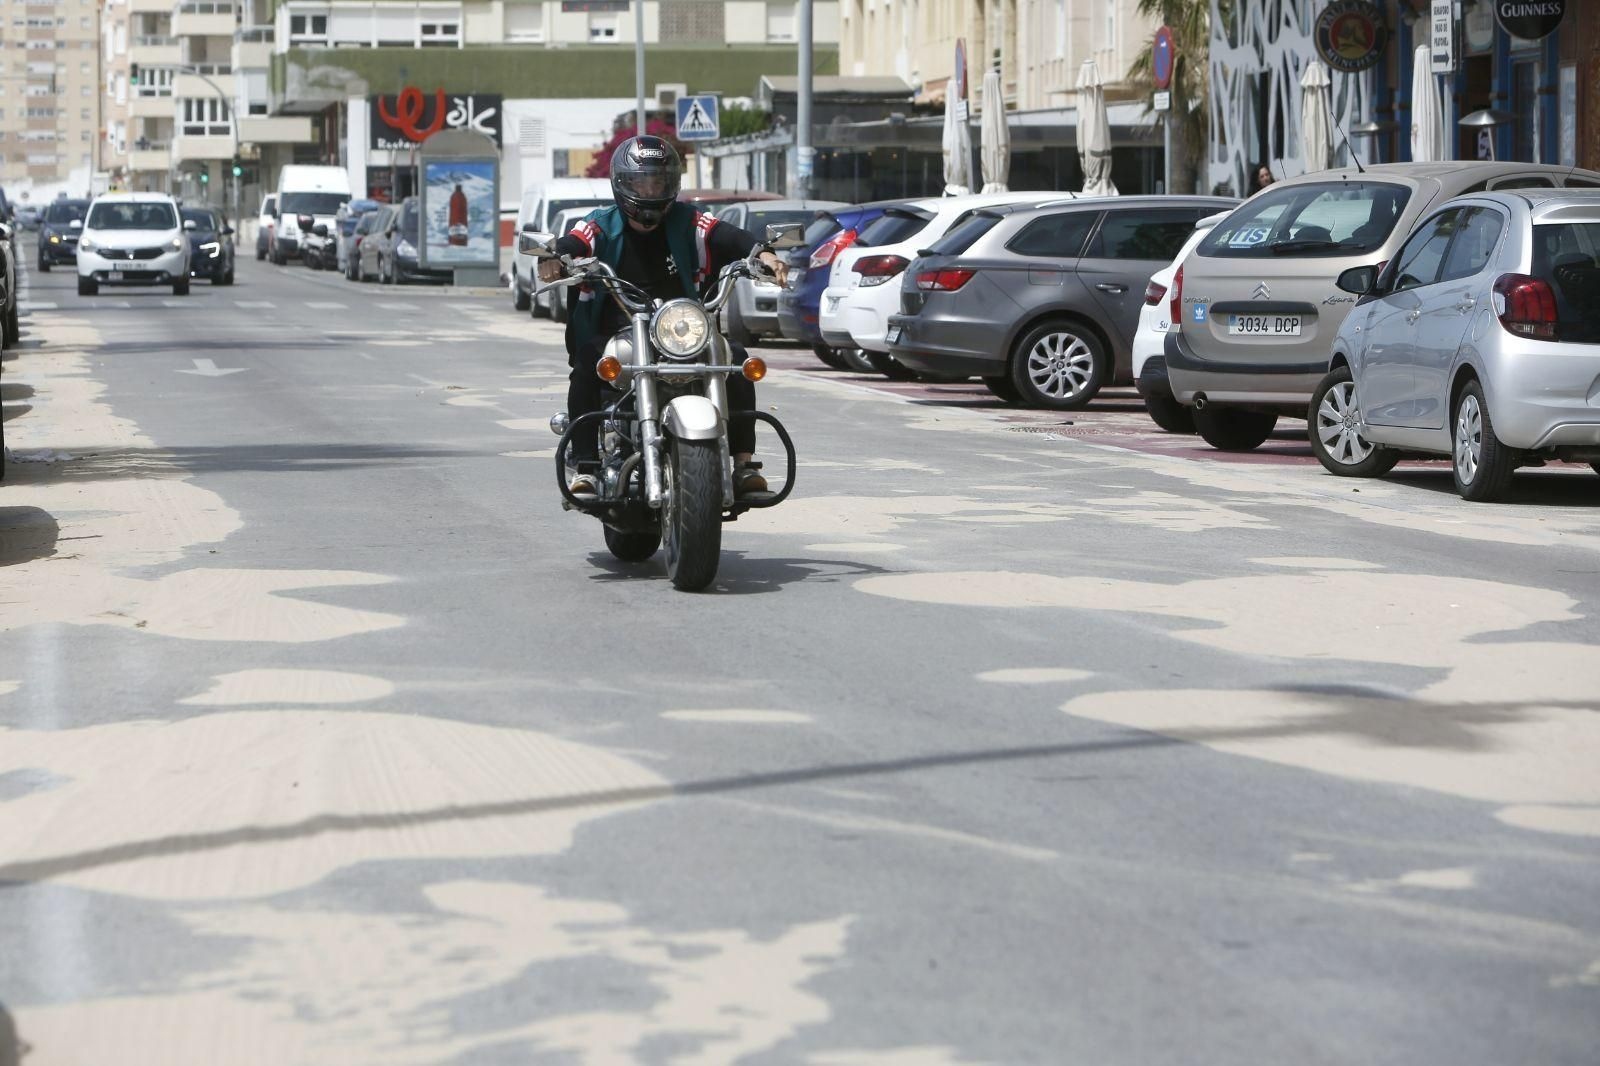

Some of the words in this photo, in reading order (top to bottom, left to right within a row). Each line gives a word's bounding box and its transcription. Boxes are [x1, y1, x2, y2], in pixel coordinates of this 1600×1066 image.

[1501, 2, 1561, 17] GUINNESS
[1238, 317, 1268, 332] 3034
[1275, 317, 1299, 332] DCP
